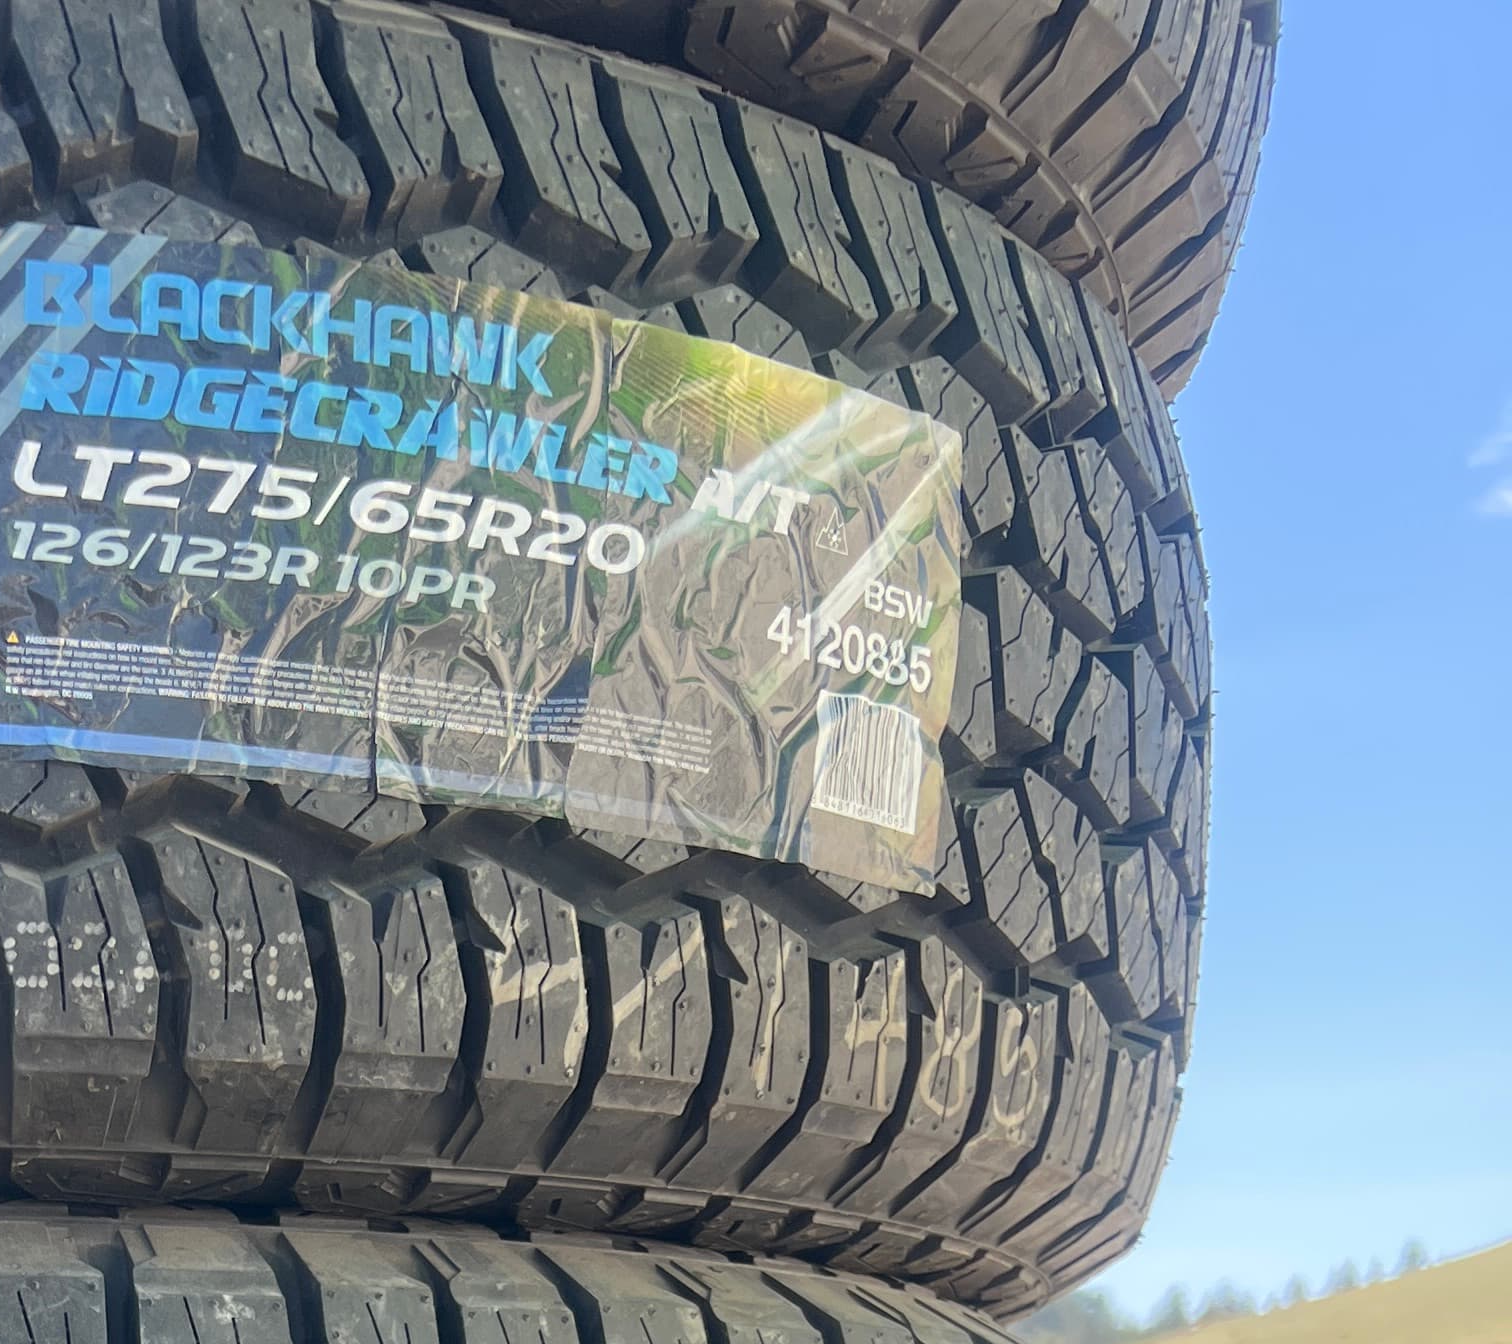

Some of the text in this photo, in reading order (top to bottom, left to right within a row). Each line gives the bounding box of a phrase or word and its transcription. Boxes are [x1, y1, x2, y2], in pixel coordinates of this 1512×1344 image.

[22, 258, 555, 398] BLACKHAWK
[12, 440, 644, 576] LT275/65R20
[691, 466, 809, 537] A/T
[10, 519, 498, 615] 126/123R 10PR
[864, 580, 935, 630] BSW
[766, 605, 933, 695] 4120885
